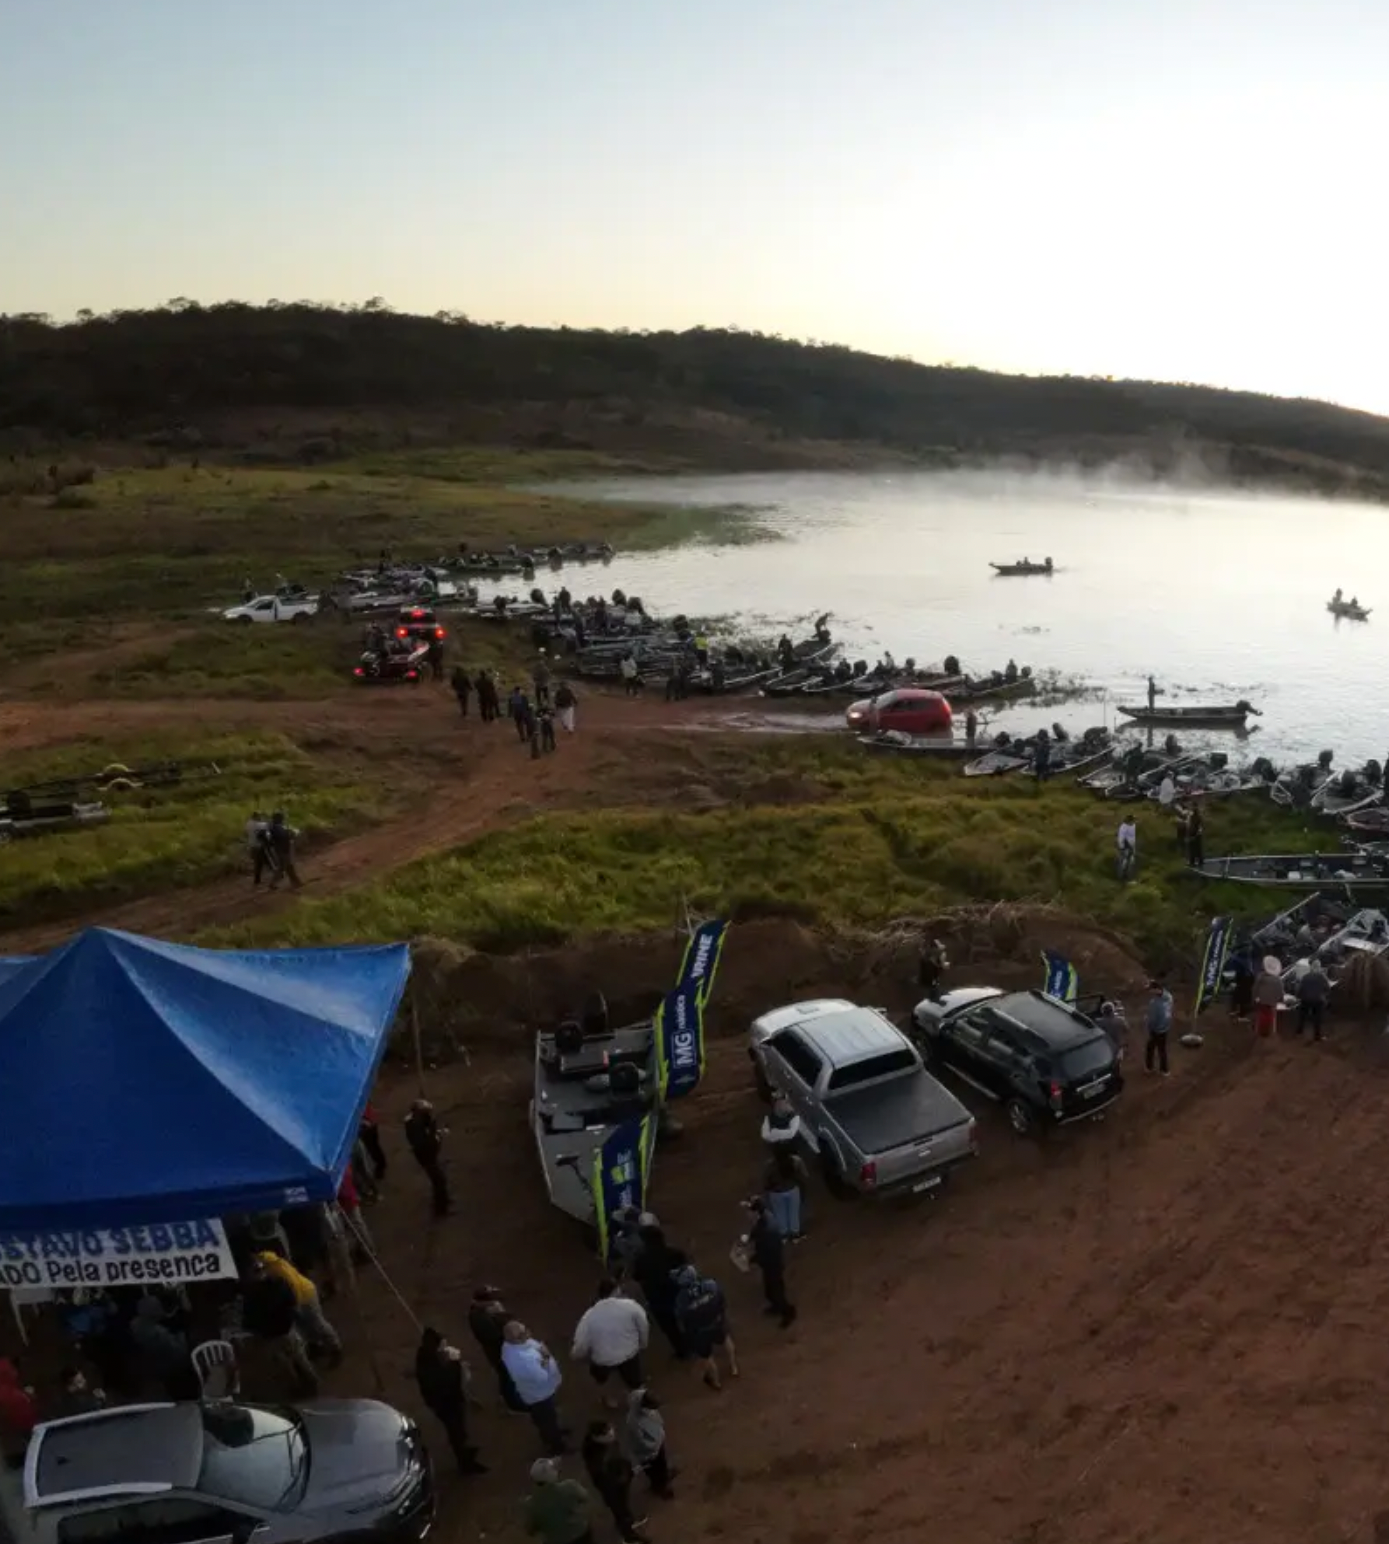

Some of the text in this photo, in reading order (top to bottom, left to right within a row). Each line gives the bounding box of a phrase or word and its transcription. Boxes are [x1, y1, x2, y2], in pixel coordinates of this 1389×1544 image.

[674, 1033, 693, 1066] MG
[110, 1220, 220, 1252] SEBBA
[47, 1258, 100, 1283] Pela
